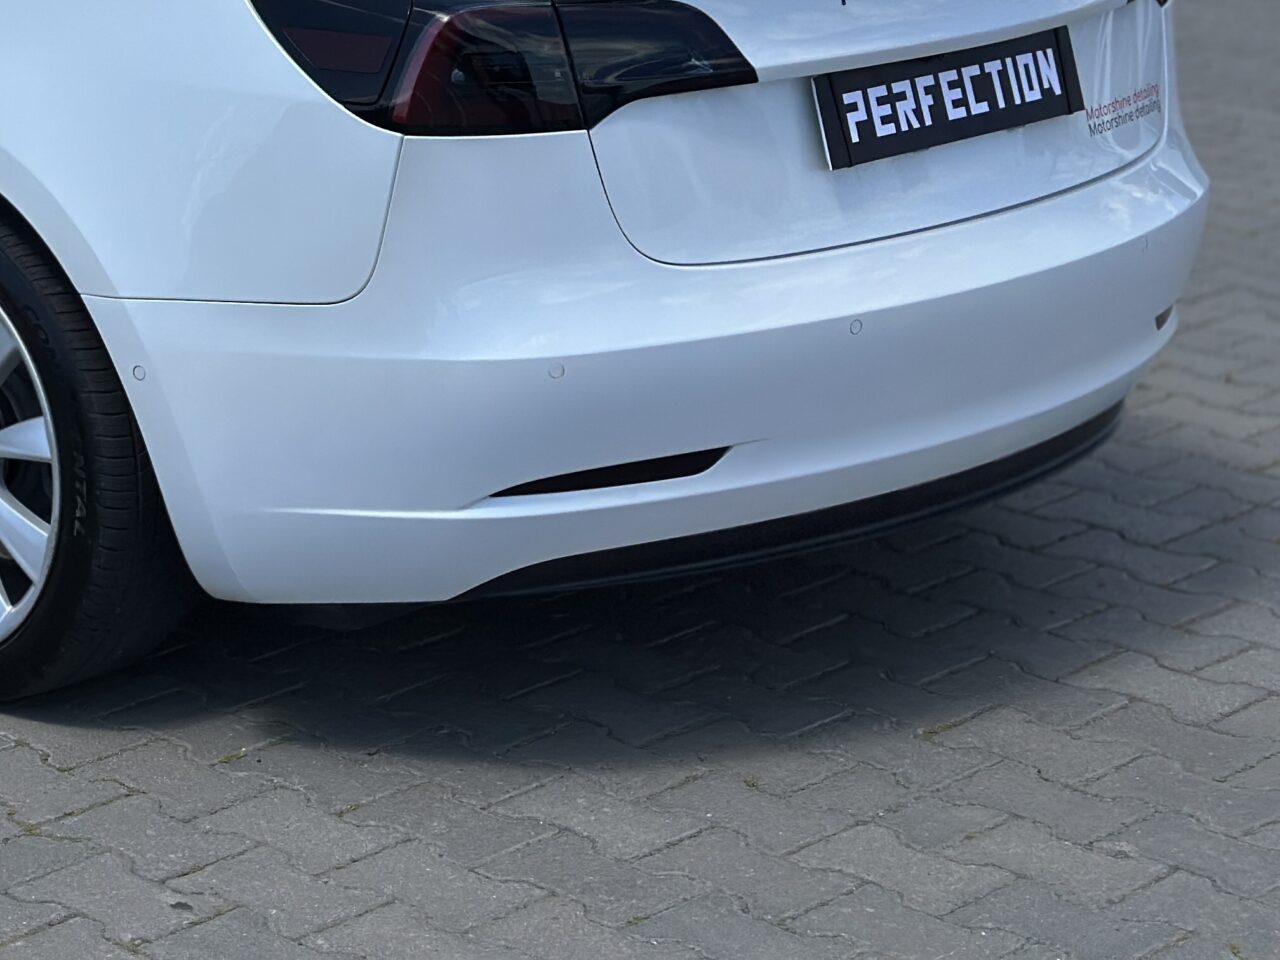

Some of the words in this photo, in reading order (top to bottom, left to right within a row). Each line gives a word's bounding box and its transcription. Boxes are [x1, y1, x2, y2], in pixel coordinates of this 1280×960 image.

[841, 47, 1062, 144] PERFECTION
[1086, 95, 1132, 121] Motorshine
[1132, 83, 1159, 103] detailing
[1088, 110, 1134, 137] Motorshine
